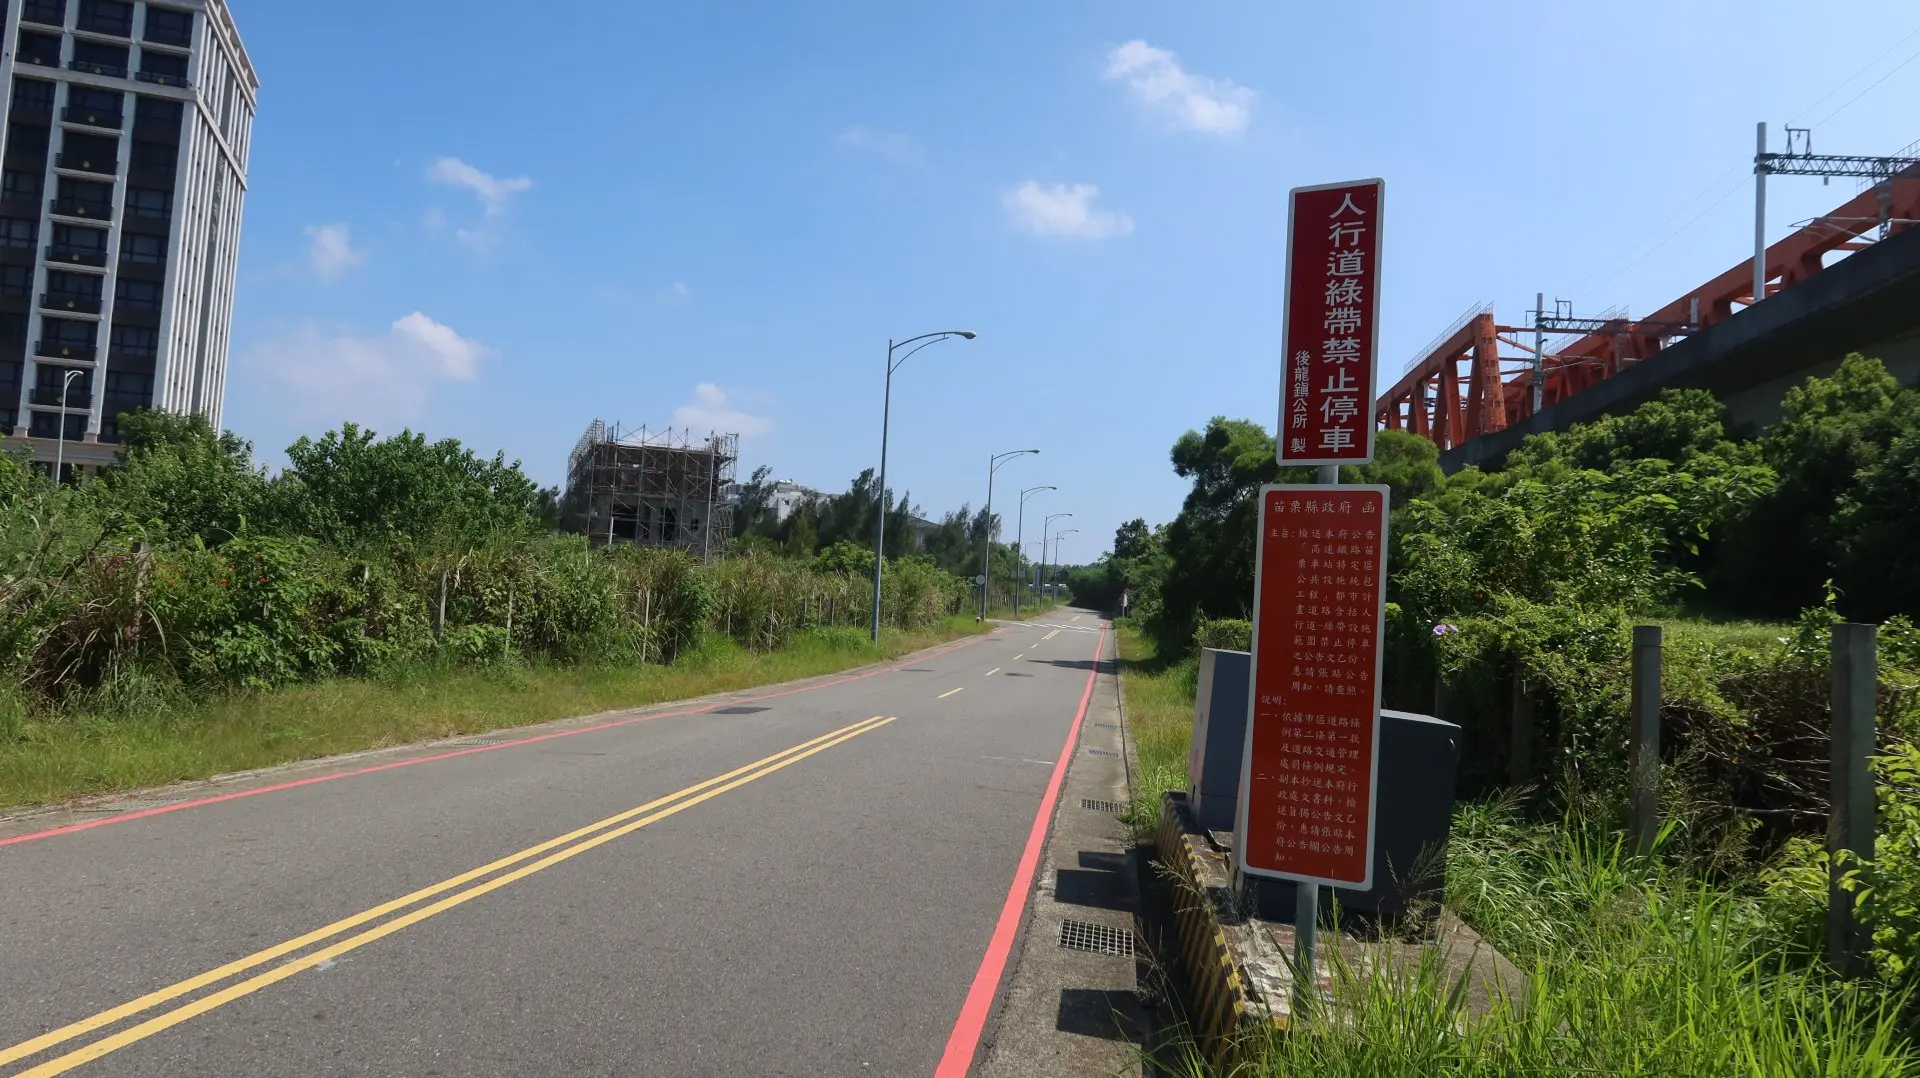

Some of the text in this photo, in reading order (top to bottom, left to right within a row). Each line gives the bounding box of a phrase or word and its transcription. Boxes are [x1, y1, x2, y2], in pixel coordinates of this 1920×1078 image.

[1318, 193, 1366, 453] 人行道綠帶禁止停車
